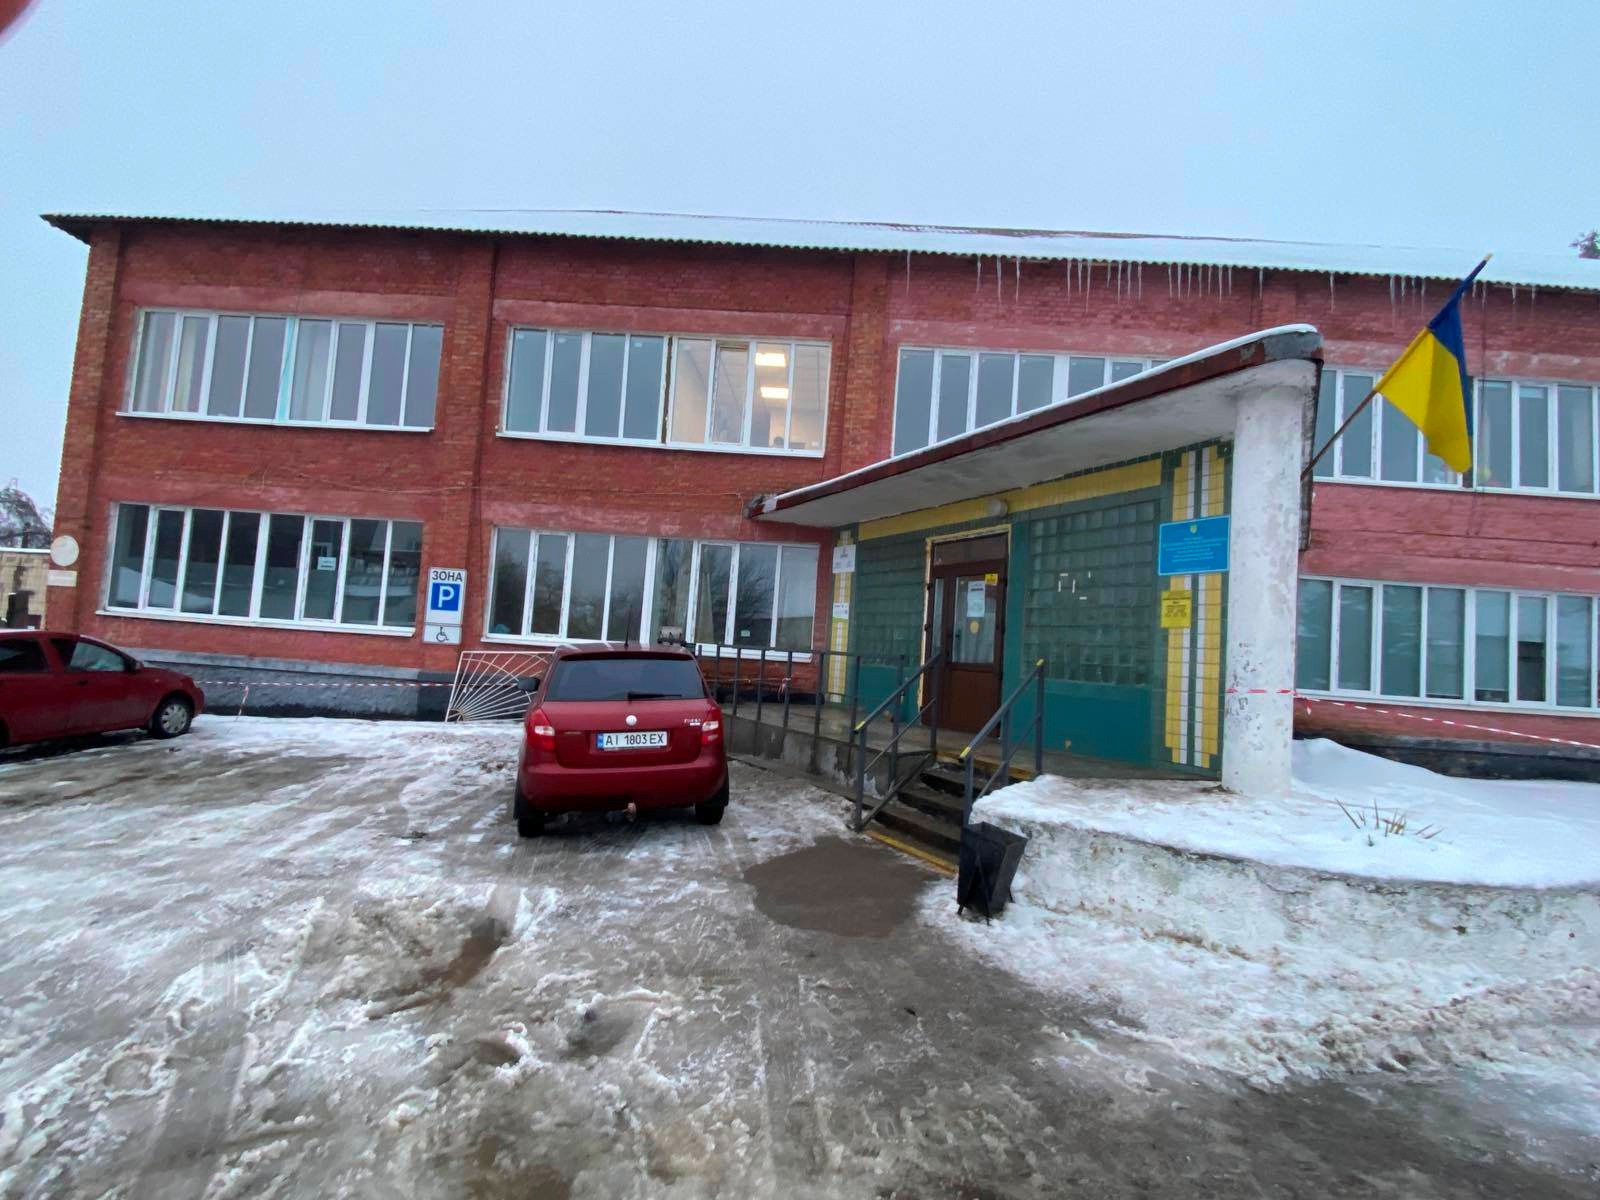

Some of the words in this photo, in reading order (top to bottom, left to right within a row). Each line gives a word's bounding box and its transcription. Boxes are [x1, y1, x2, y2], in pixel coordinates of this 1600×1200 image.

[432, 570, 463, 582] ЗОНА
[438, 585, 455, 608] P
[605, 735, 619, 746] AI
[624, 734, 648, 745] 1803
[649, 733, 664, 744] EX
